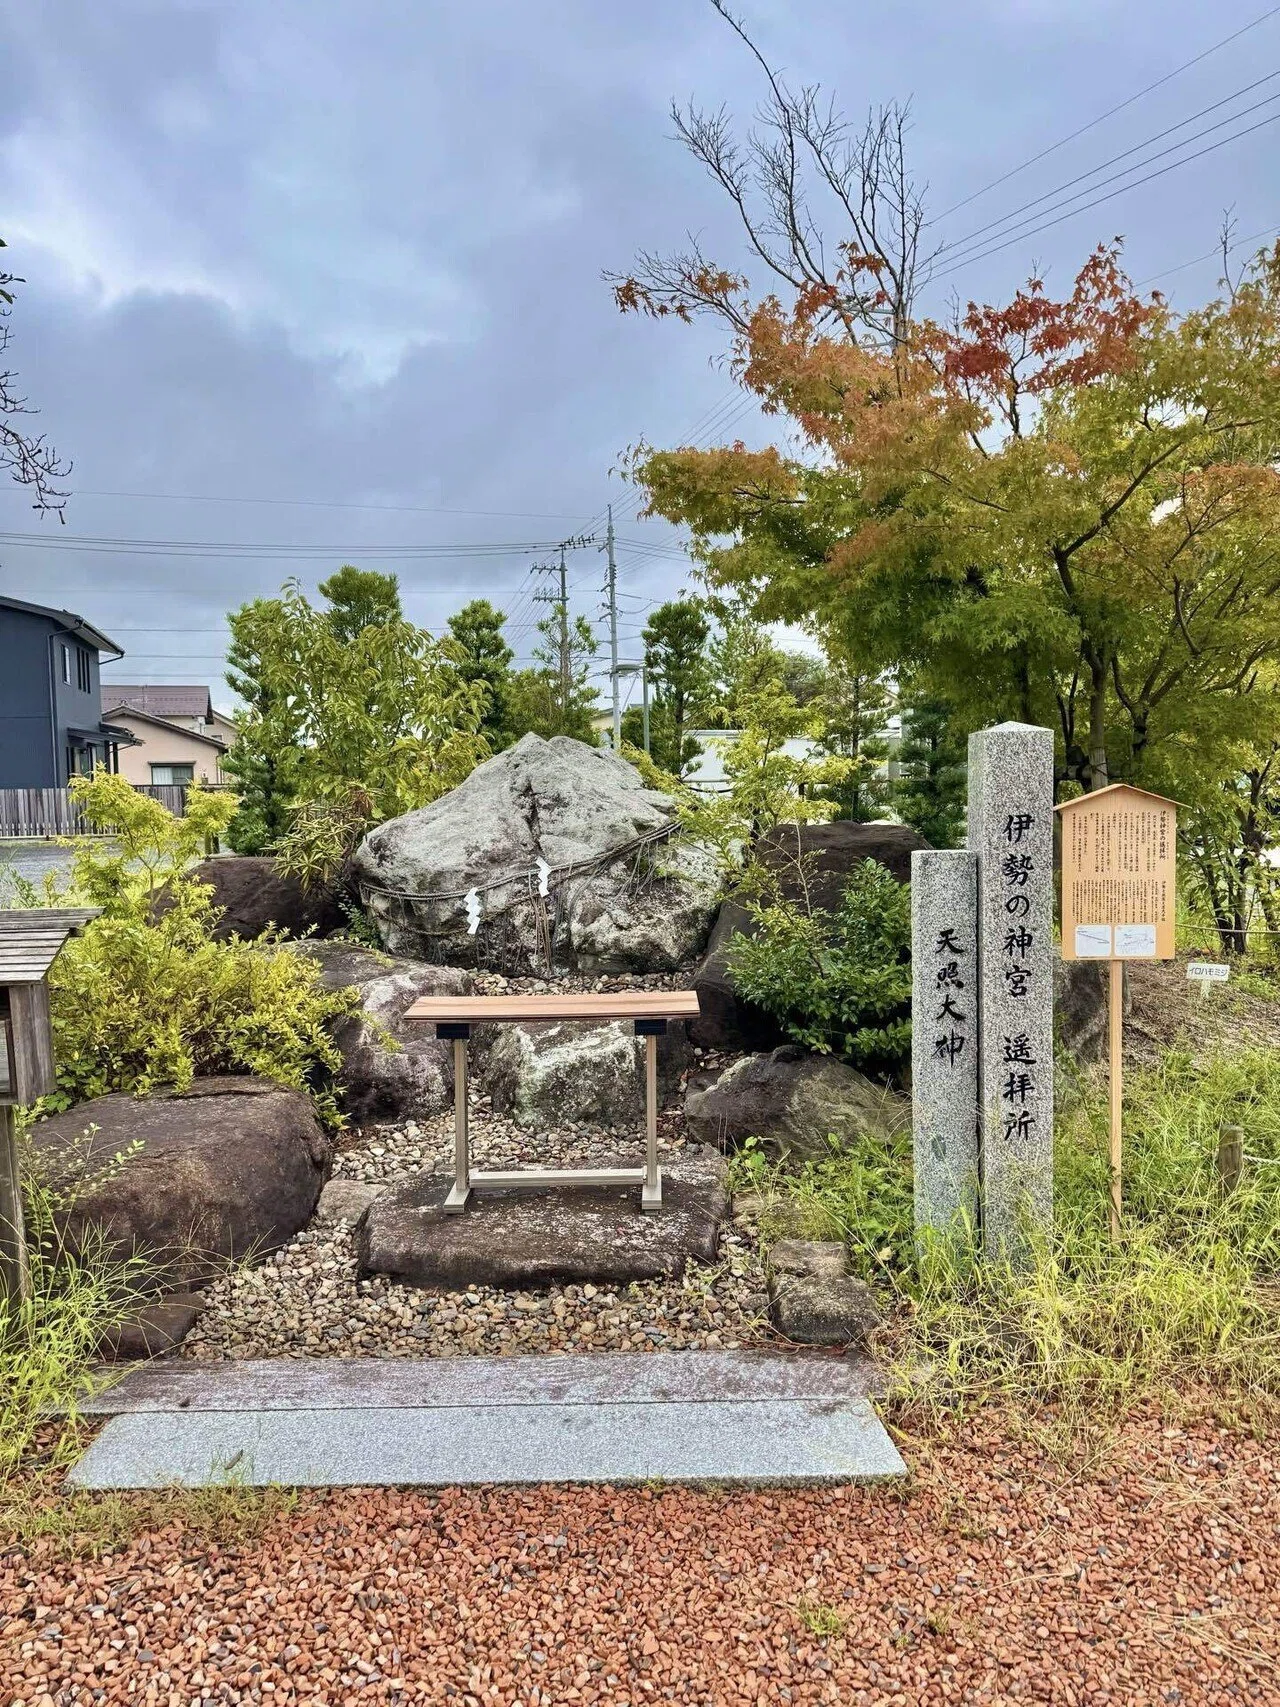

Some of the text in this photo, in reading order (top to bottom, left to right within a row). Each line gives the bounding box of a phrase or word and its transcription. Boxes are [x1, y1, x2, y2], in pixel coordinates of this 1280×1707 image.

[932, 928, 966, 1068] 天照大神
[1003, 814, 1036, 1141] 伊勢の神宮 遥拝所
[1189, 967, 1228, 977] イロハモミジ
